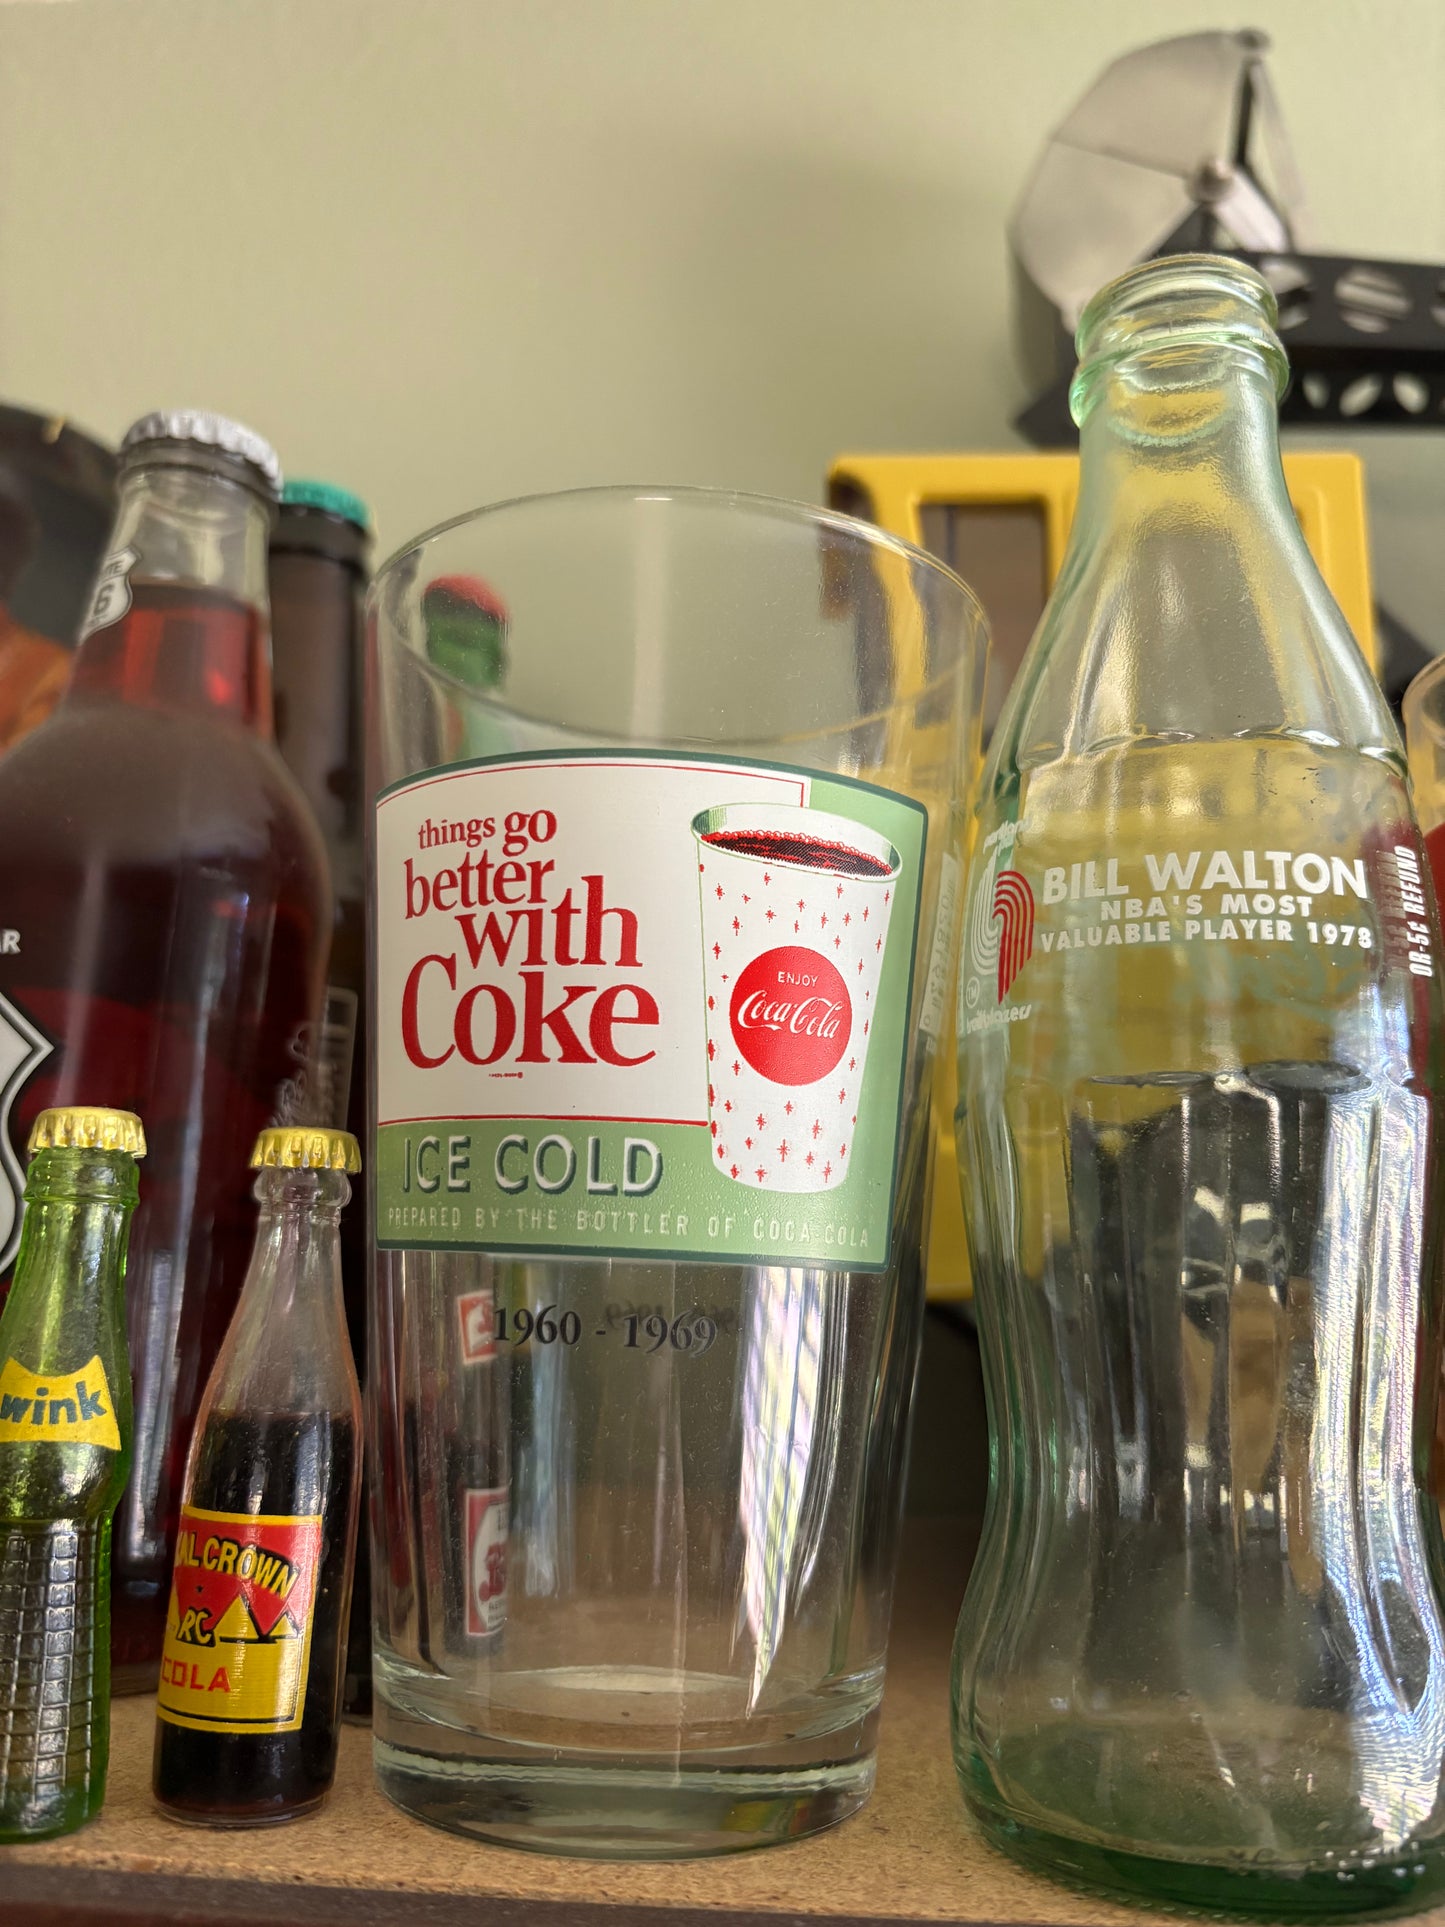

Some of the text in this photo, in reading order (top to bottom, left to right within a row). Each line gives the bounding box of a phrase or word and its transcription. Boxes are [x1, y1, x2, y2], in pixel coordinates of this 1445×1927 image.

[413, 809, 558, 857] things go
[403, 848, 556, 920] better
[1041, 850, 1368, 905] BILL WALTON
[1394, 845, 1427, 917] REFUND
[454, 874, 644, 970] with
[1100, 893, 1313, 921] NBA'S MOST
[1040, 918, 1373, 953] VALUABLE PLAYER 1978
[777, 971, 819, 987] ENJOY
[401, 952, 660, 1069] Coke
[403, 1134, 663, 1195] ICE COLD
[388, 1207, 461, 1227] PREPARED
[475, 1207, 500, 1229] BY
[515, 1207, 558, 1231] THE
[576, 1209, 689, 1237] BOTTLER
[707, 1215, 735, 1238] OF
[494, 1304, 582, 1346] 1960
[623, 1308, 718, 1358] 1969
[0, 1380, 108, 1426] wink
[202, 1537, 299, 1600] CROWN
[176, 1608, 213, 1645] RC
[161, 1655, 233, 1693] COLA
